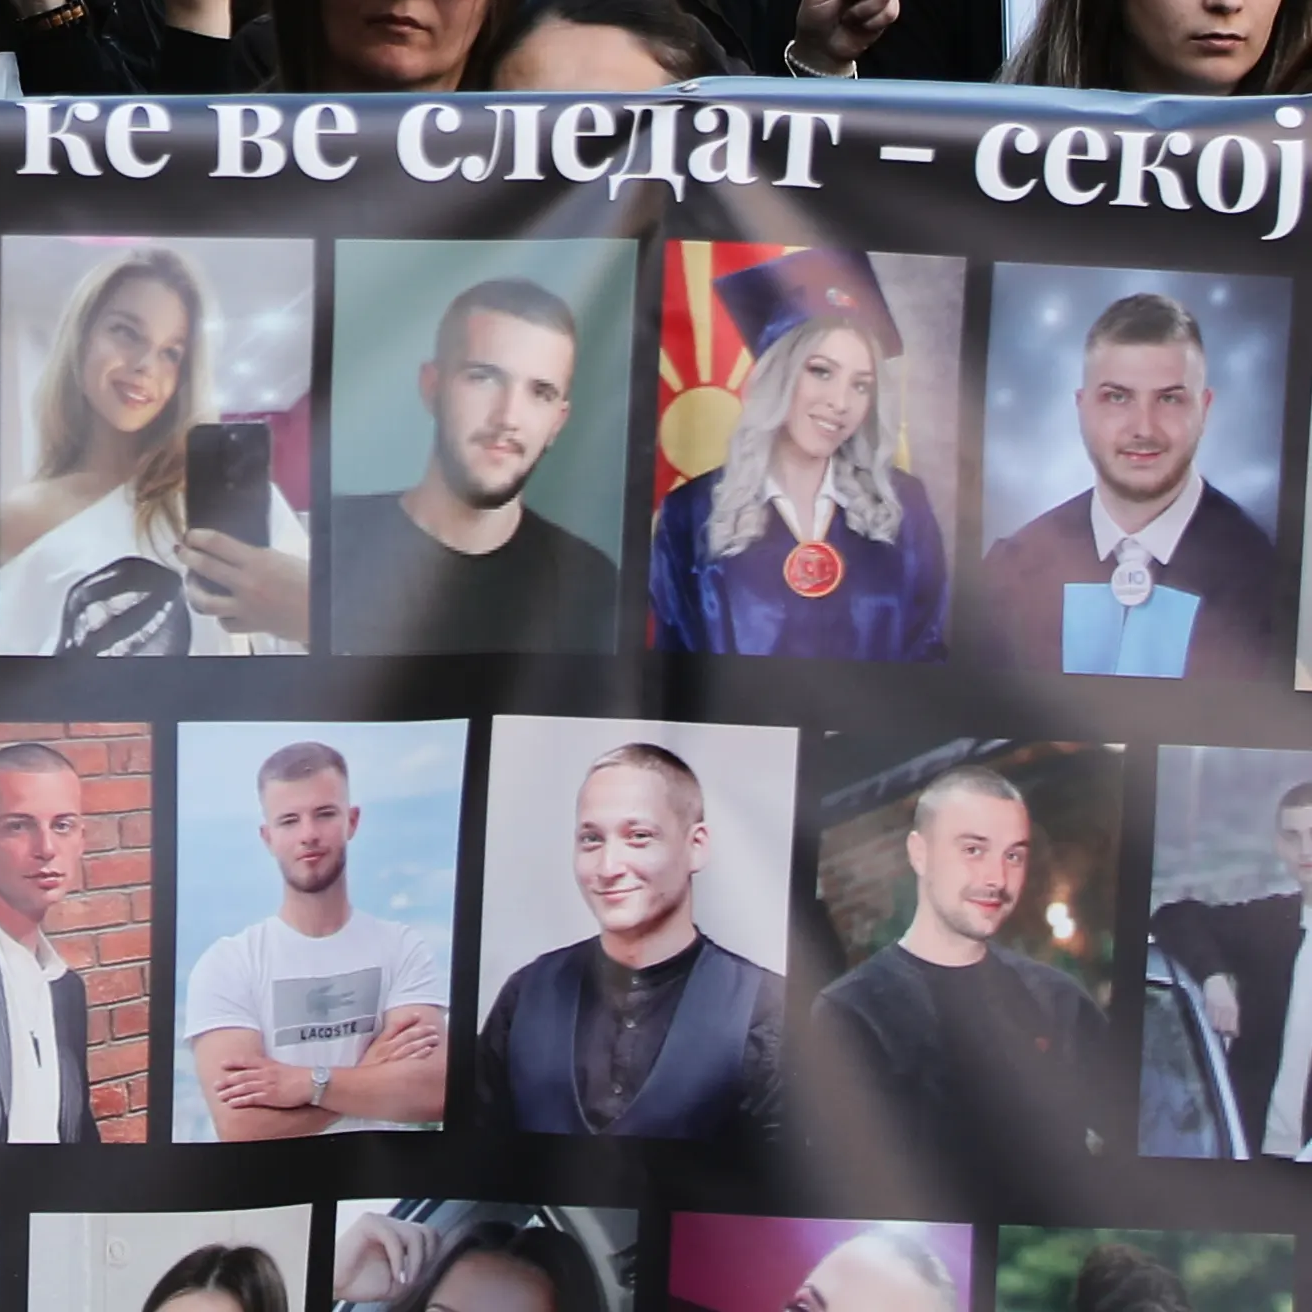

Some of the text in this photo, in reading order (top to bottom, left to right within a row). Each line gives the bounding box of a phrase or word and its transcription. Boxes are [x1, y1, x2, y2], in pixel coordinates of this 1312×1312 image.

[207, 99, 359, 181] ве
[394, 99, 843, 204] следат
[974, 105, 1308, 242] секој
[299, 1020, 359, 1042] LACOSTE
